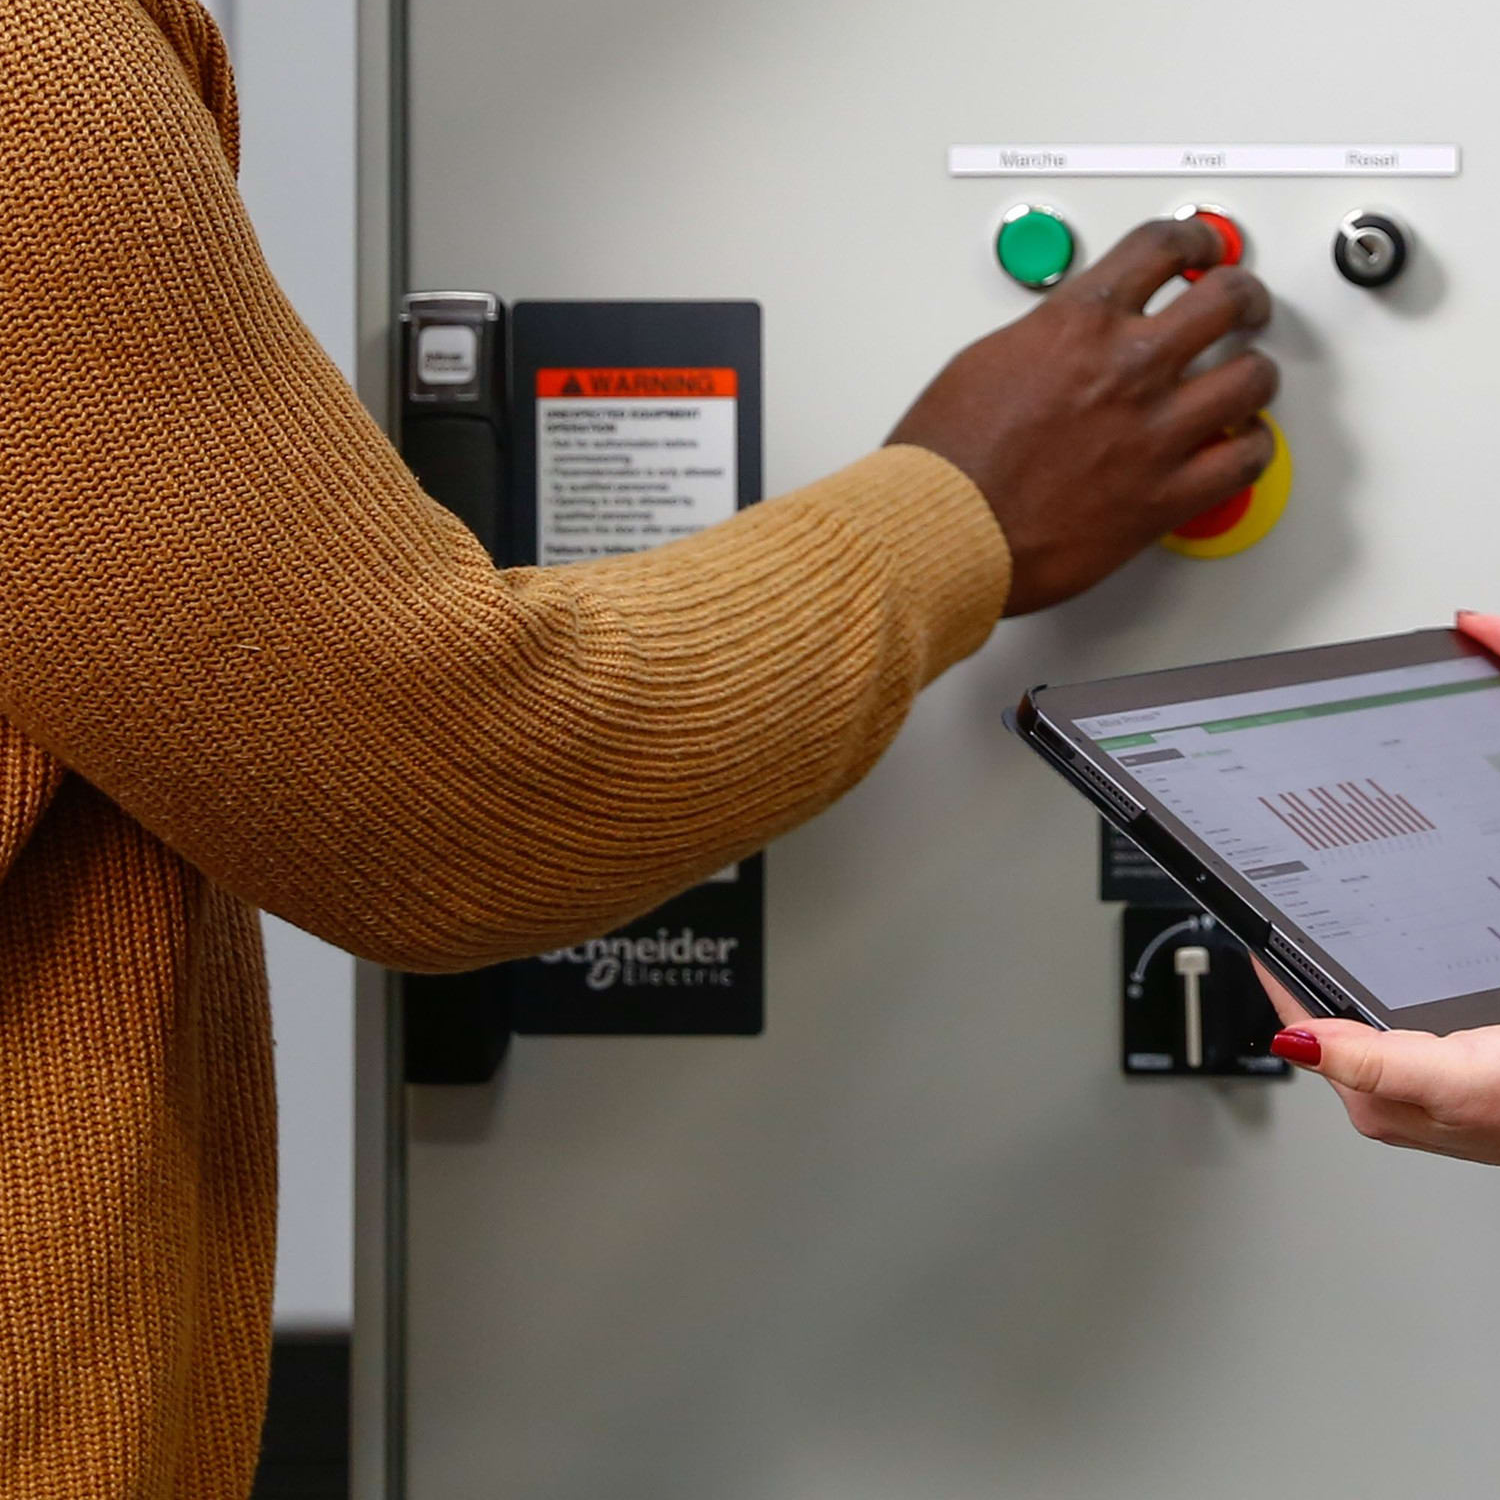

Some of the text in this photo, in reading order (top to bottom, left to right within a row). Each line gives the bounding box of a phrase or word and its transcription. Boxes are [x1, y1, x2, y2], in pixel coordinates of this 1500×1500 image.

[1346, 152, 1398, 167] Reset
[589, 373, 716, 392] WARNING
[622, 967, 735, 987] Electric
